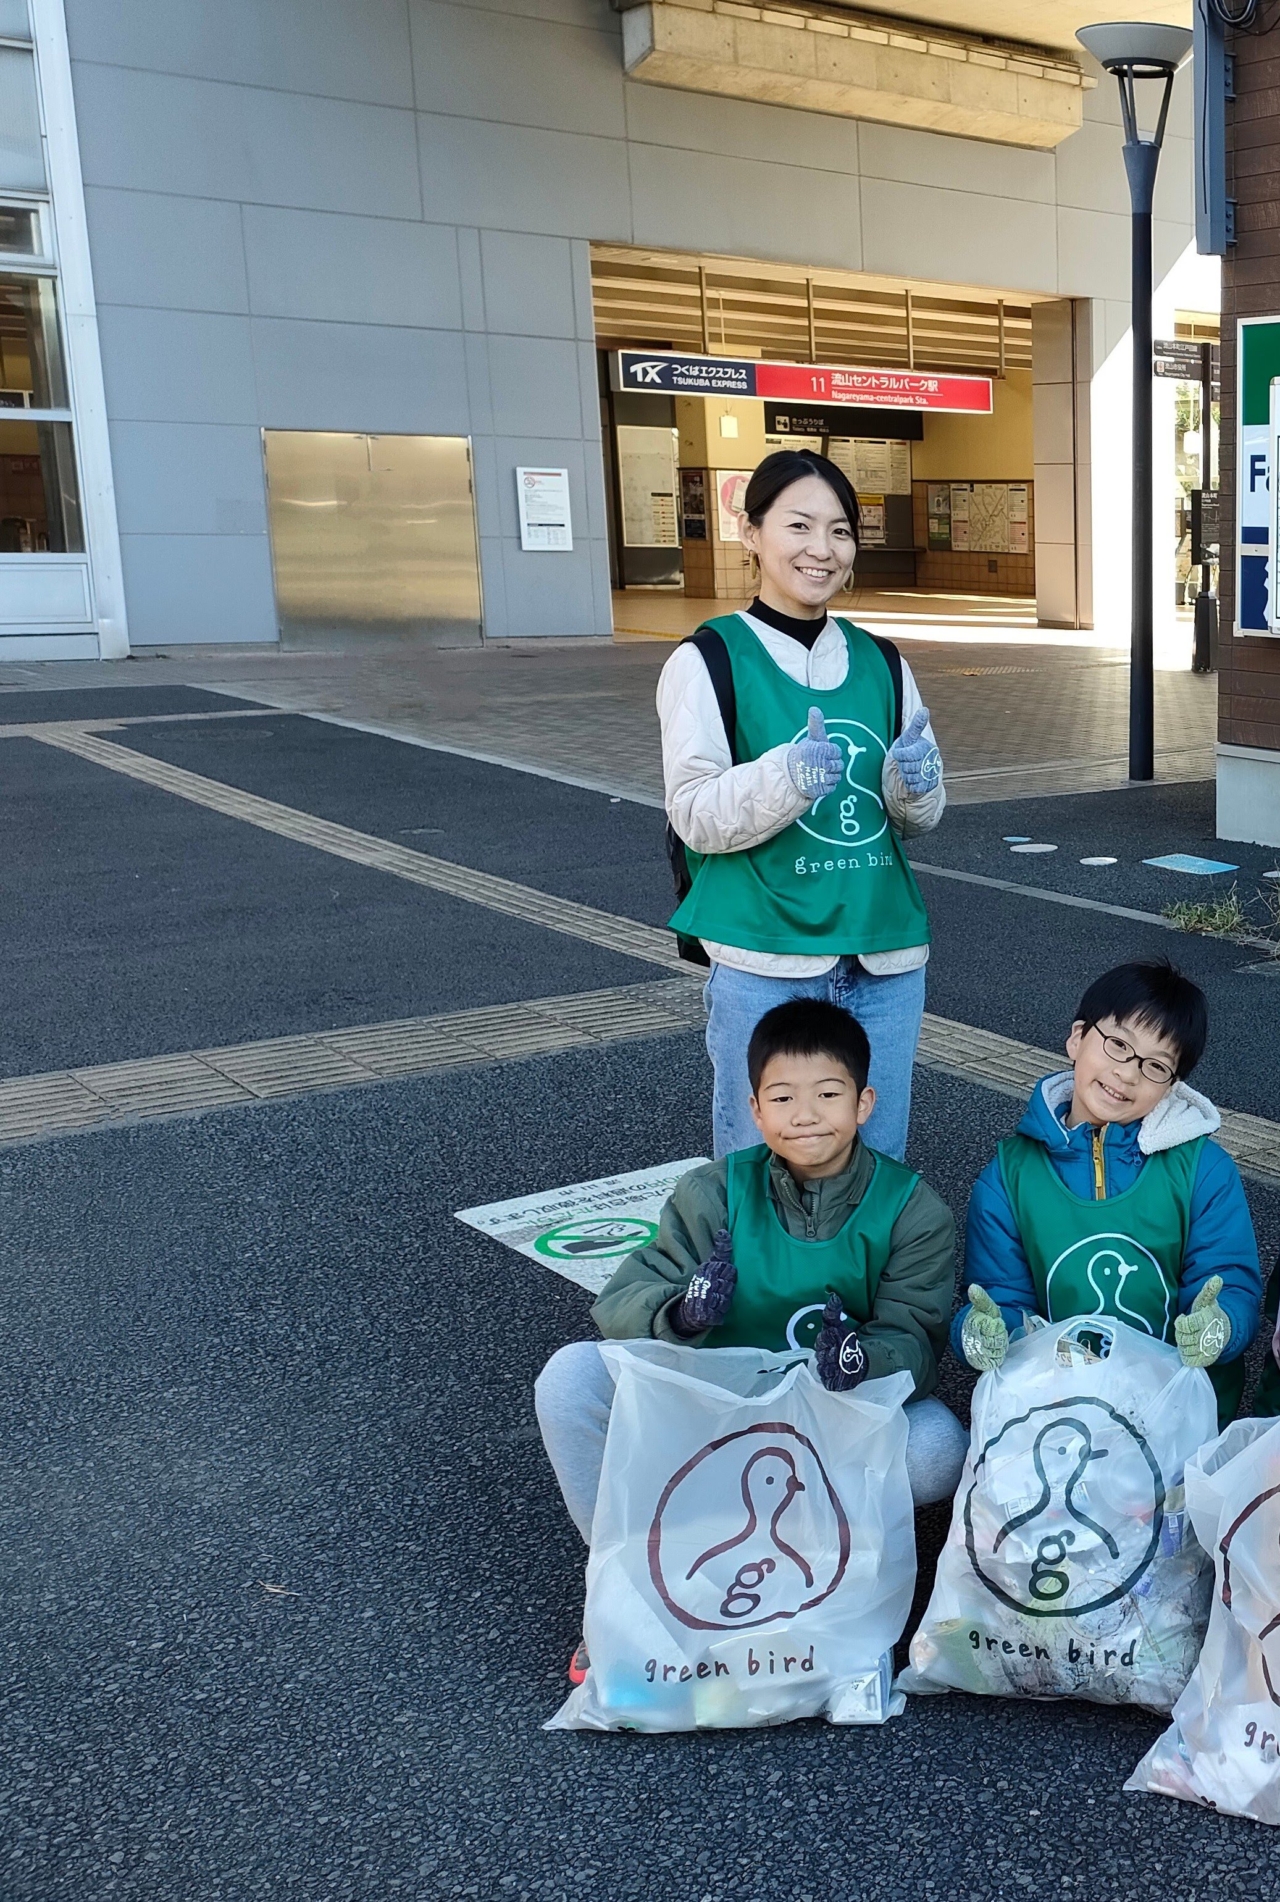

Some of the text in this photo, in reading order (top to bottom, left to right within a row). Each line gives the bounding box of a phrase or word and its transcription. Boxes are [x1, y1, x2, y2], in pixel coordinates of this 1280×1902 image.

[629, 361, 670, 384] TX
[671, 364, 748, 380] つくばエクスプレス
[672, 376, 748, 390] TSUKUBA EXPRESS
[811, 376, 826, 393] 11
[830, 373, 939, 392] 流山セントラルパーク駅
[794, 856, 861, 875] green
[968, 1630, 1137, 1667] green bird
[644, 1644, 815, 1683] green bird
